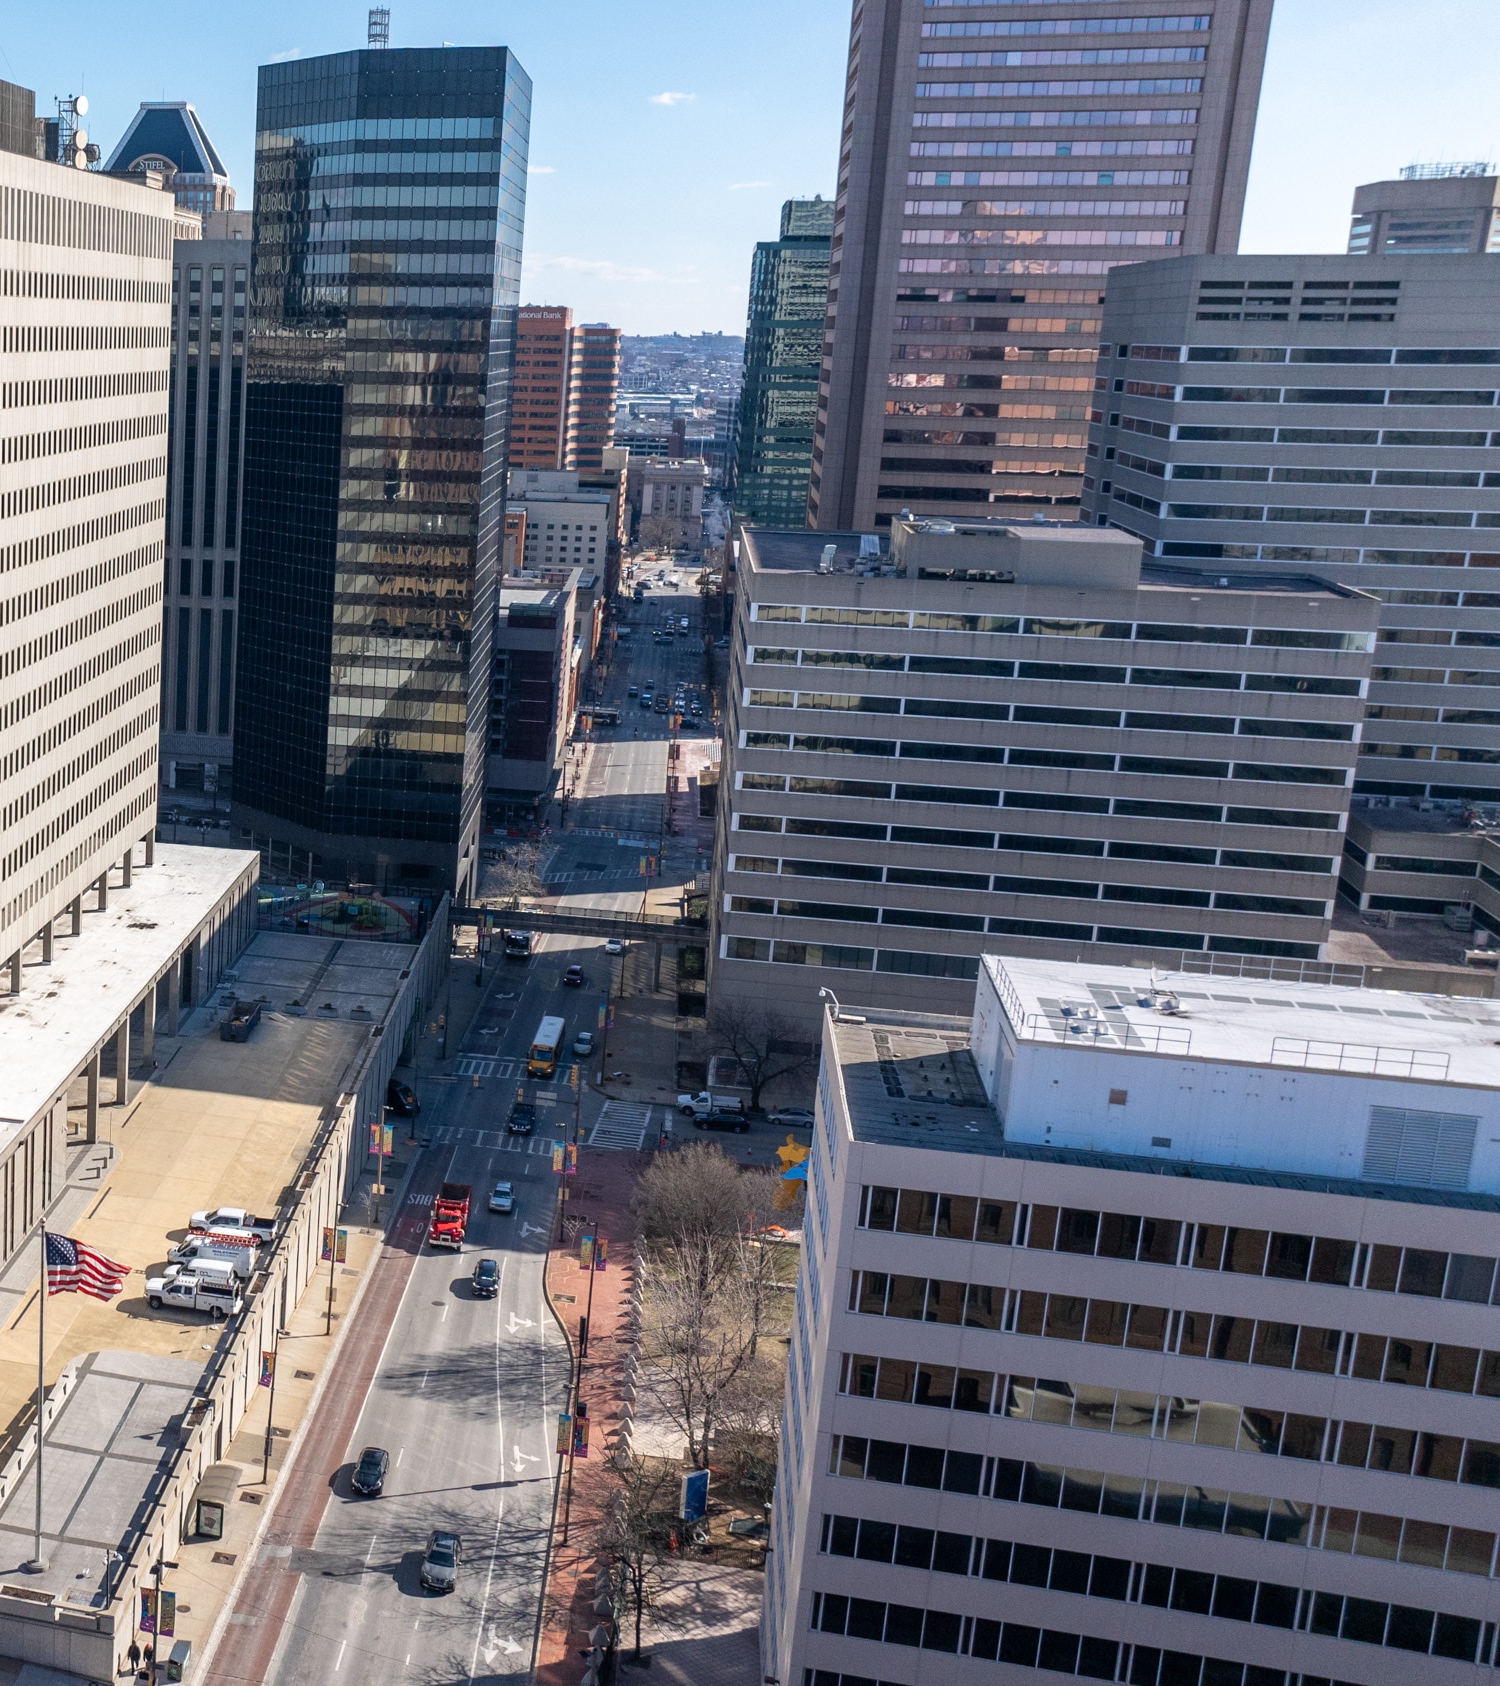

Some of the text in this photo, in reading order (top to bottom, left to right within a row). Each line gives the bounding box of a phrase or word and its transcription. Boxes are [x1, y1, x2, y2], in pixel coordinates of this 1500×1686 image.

[139, 159, 165, 170] STIFEL
[518, 311, 561, 319] ational Bank
[407, 1193, 434, 1206] BUS
